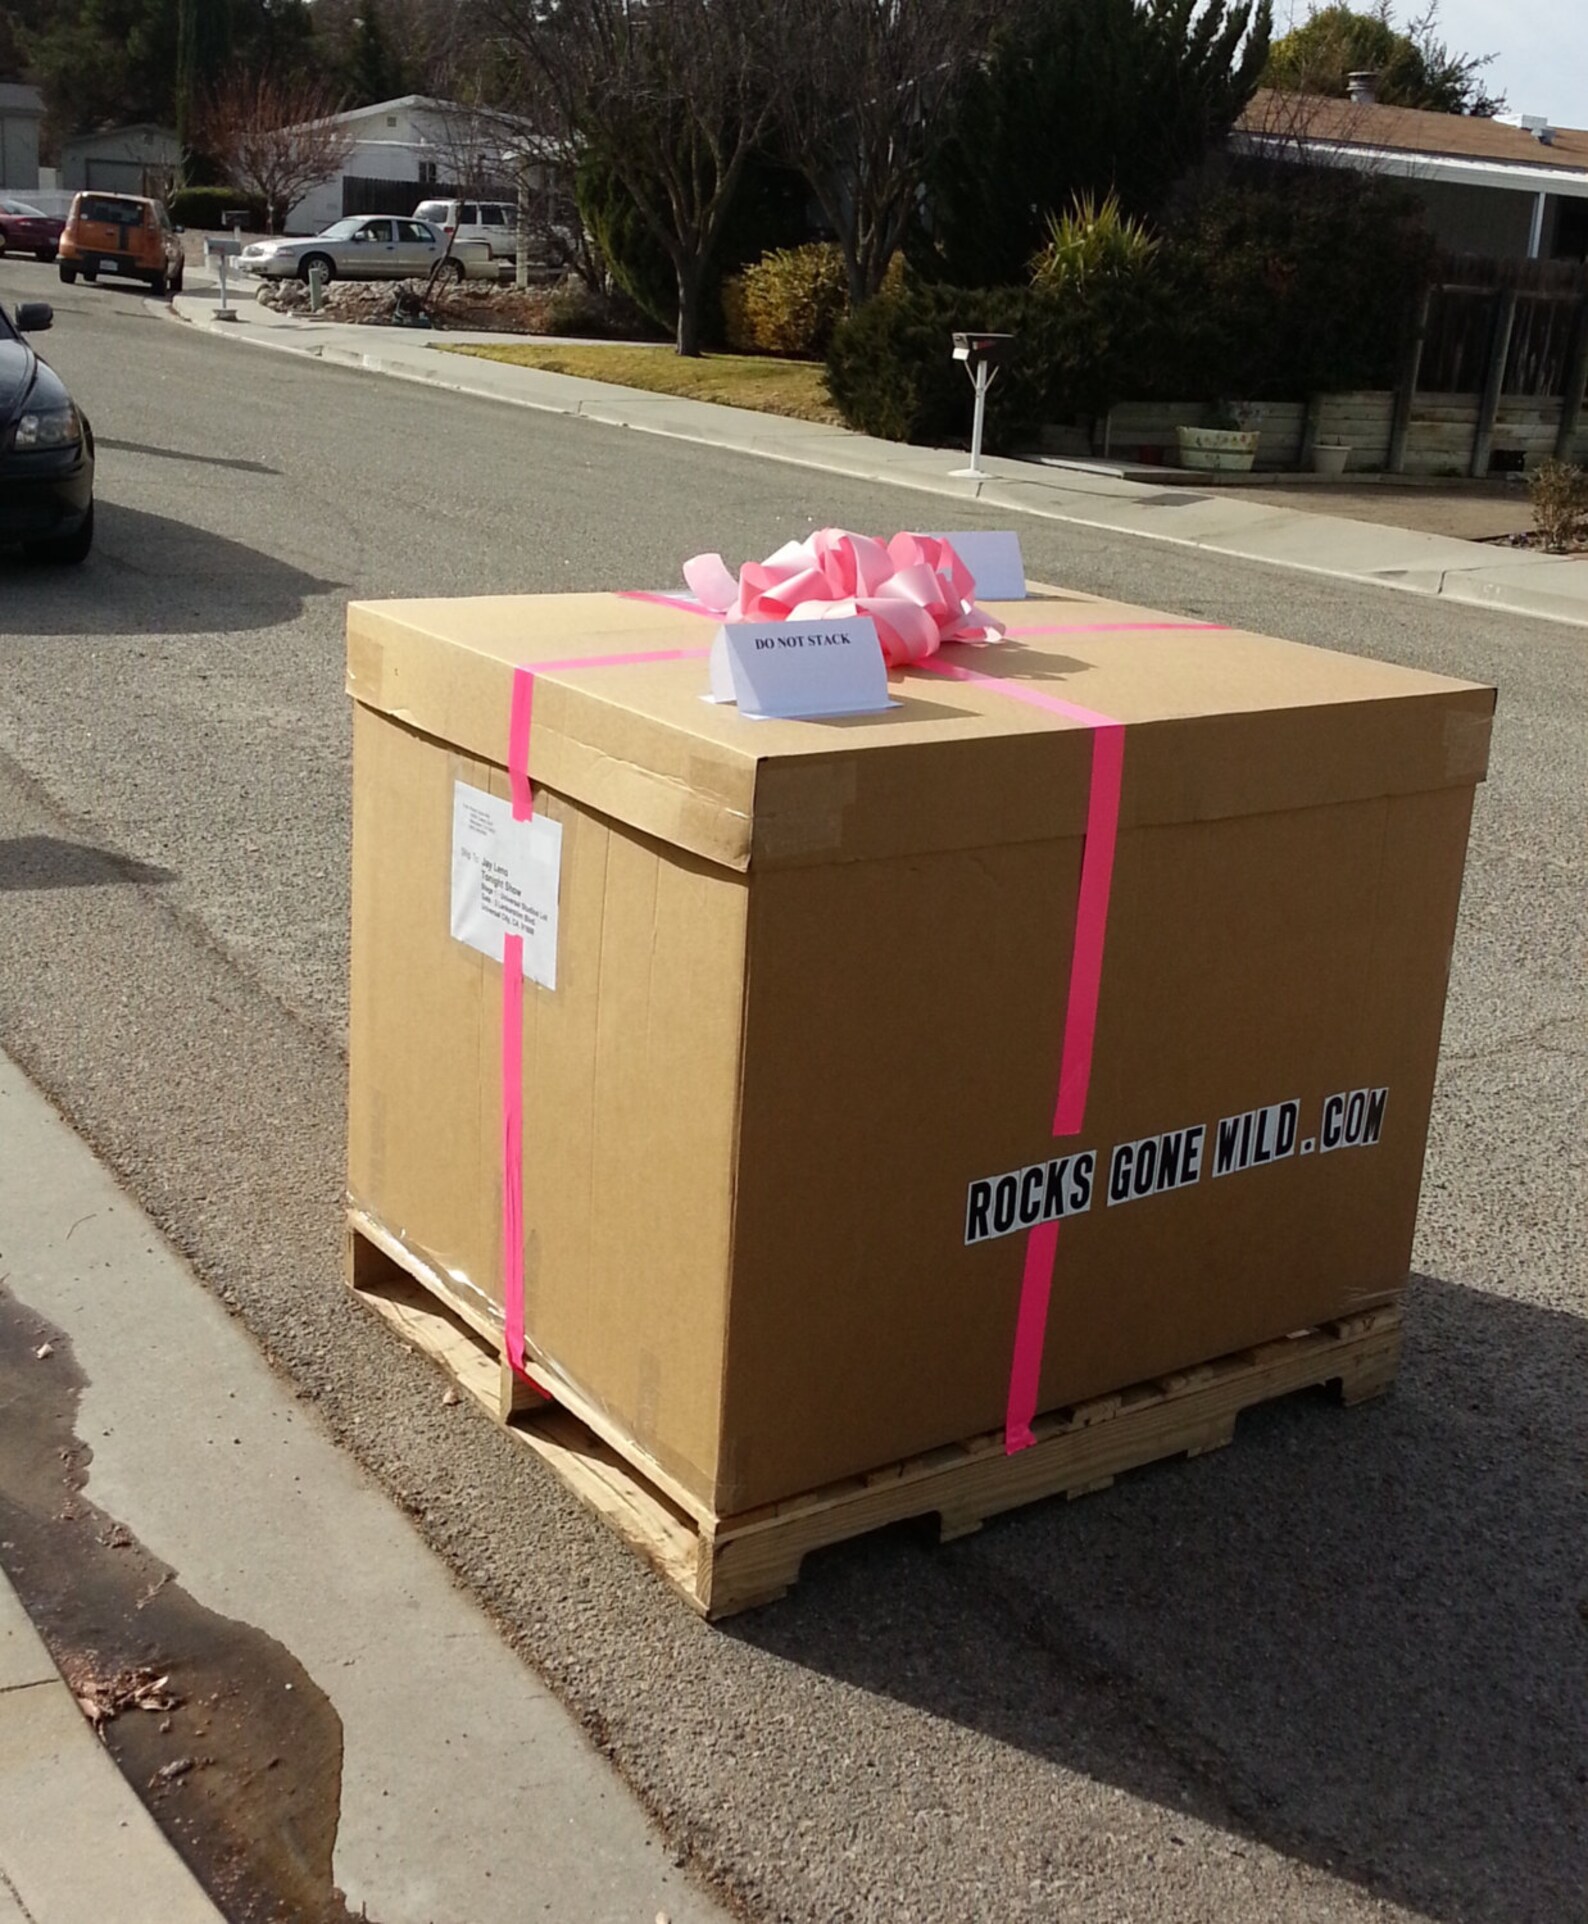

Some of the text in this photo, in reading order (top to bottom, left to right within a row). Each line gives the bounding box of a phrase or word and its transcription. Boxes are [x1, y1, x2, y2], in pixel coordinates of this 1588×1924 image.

[755, 632, 851, 650] DO NOT STACK
[481, 857, 493, 873] Jay
[481, 869, 505, 889] Tonight
[504, 881, 522, 897] Show
[966, 1150, 1095, 1242] ROCKS
[1109, 1126, 1205, 1203] GONE
